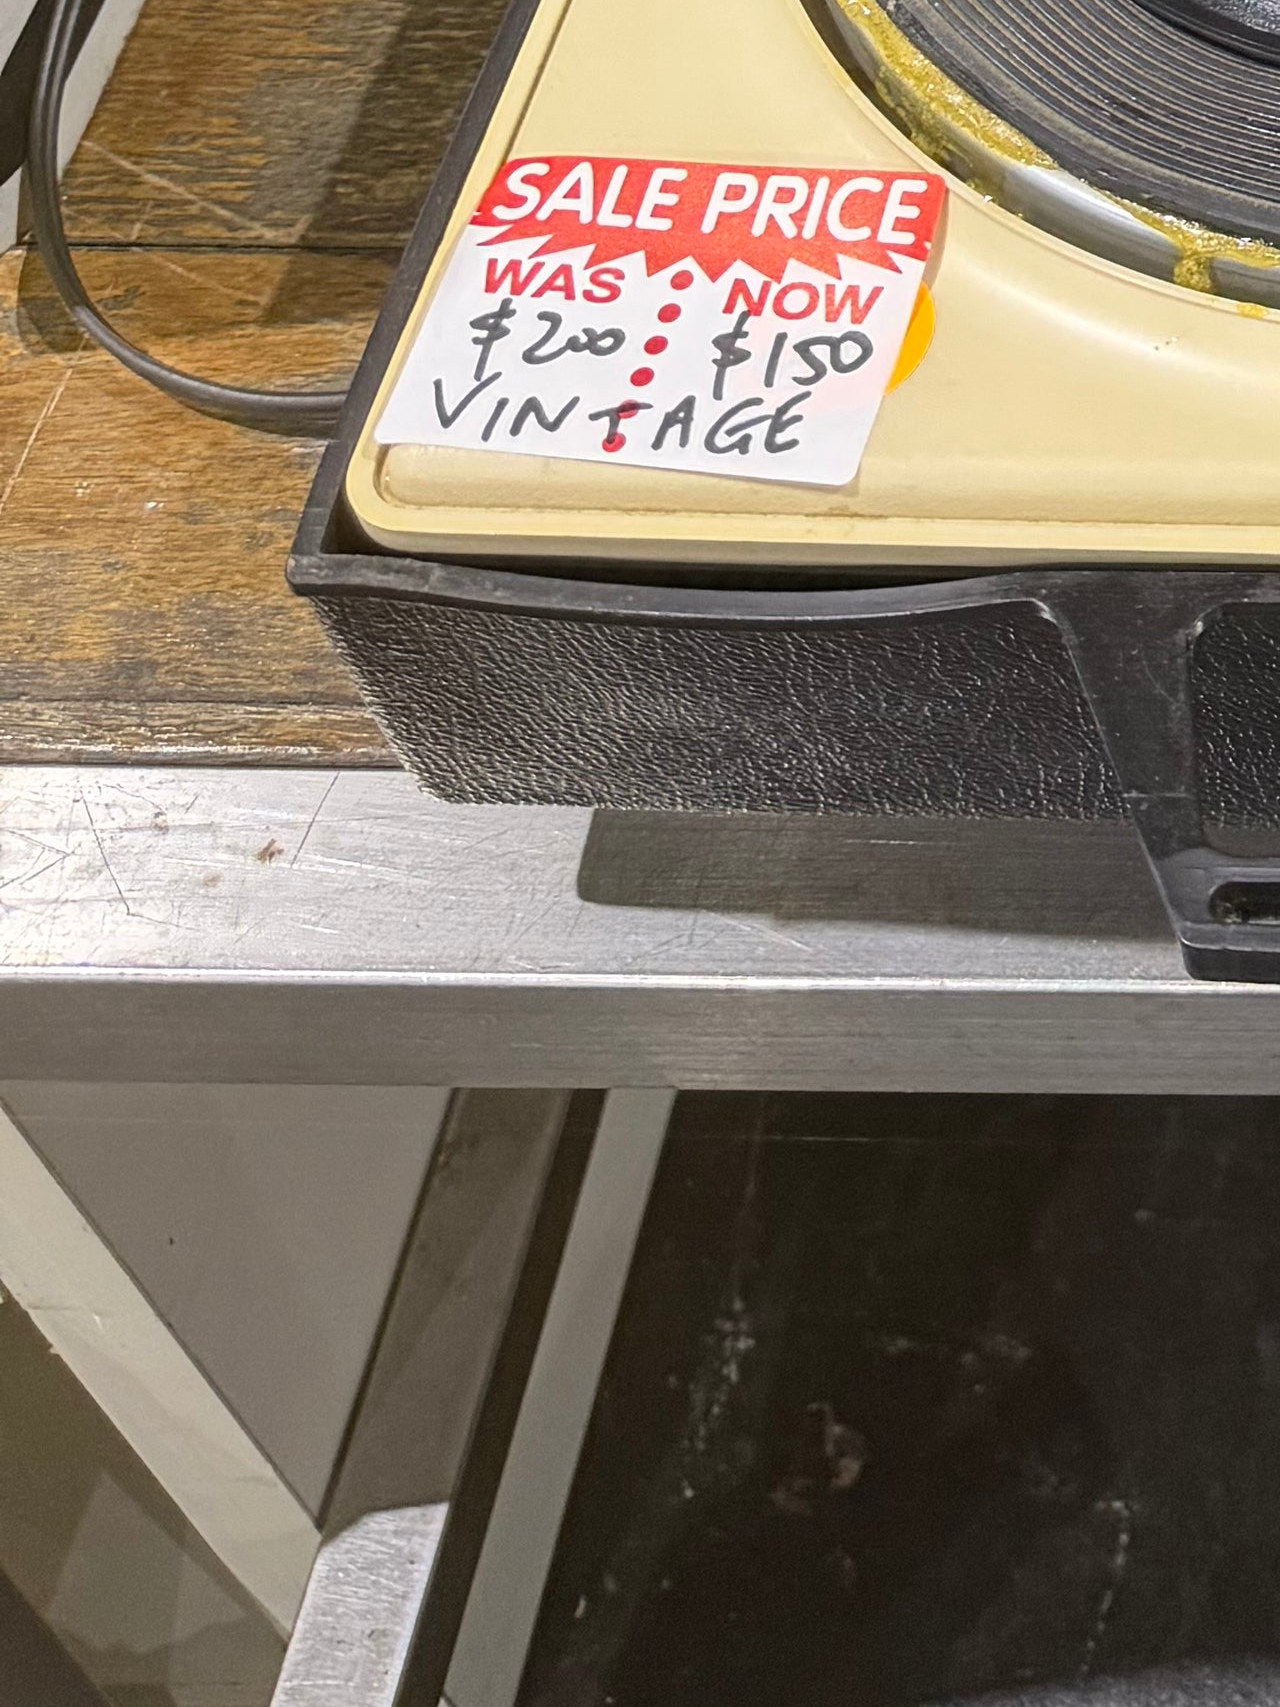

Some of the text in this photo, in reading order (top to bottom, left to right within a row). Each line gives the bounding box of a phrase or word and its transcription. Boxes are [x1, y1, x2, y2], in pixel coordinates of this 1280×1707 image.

[491, 161, 928, 245] SALE PRICE
[484, 257, 884, 325] WAS NOW
[712, 311, 874, 400] $150
[433, 371, 812, 454] VINTAGE
